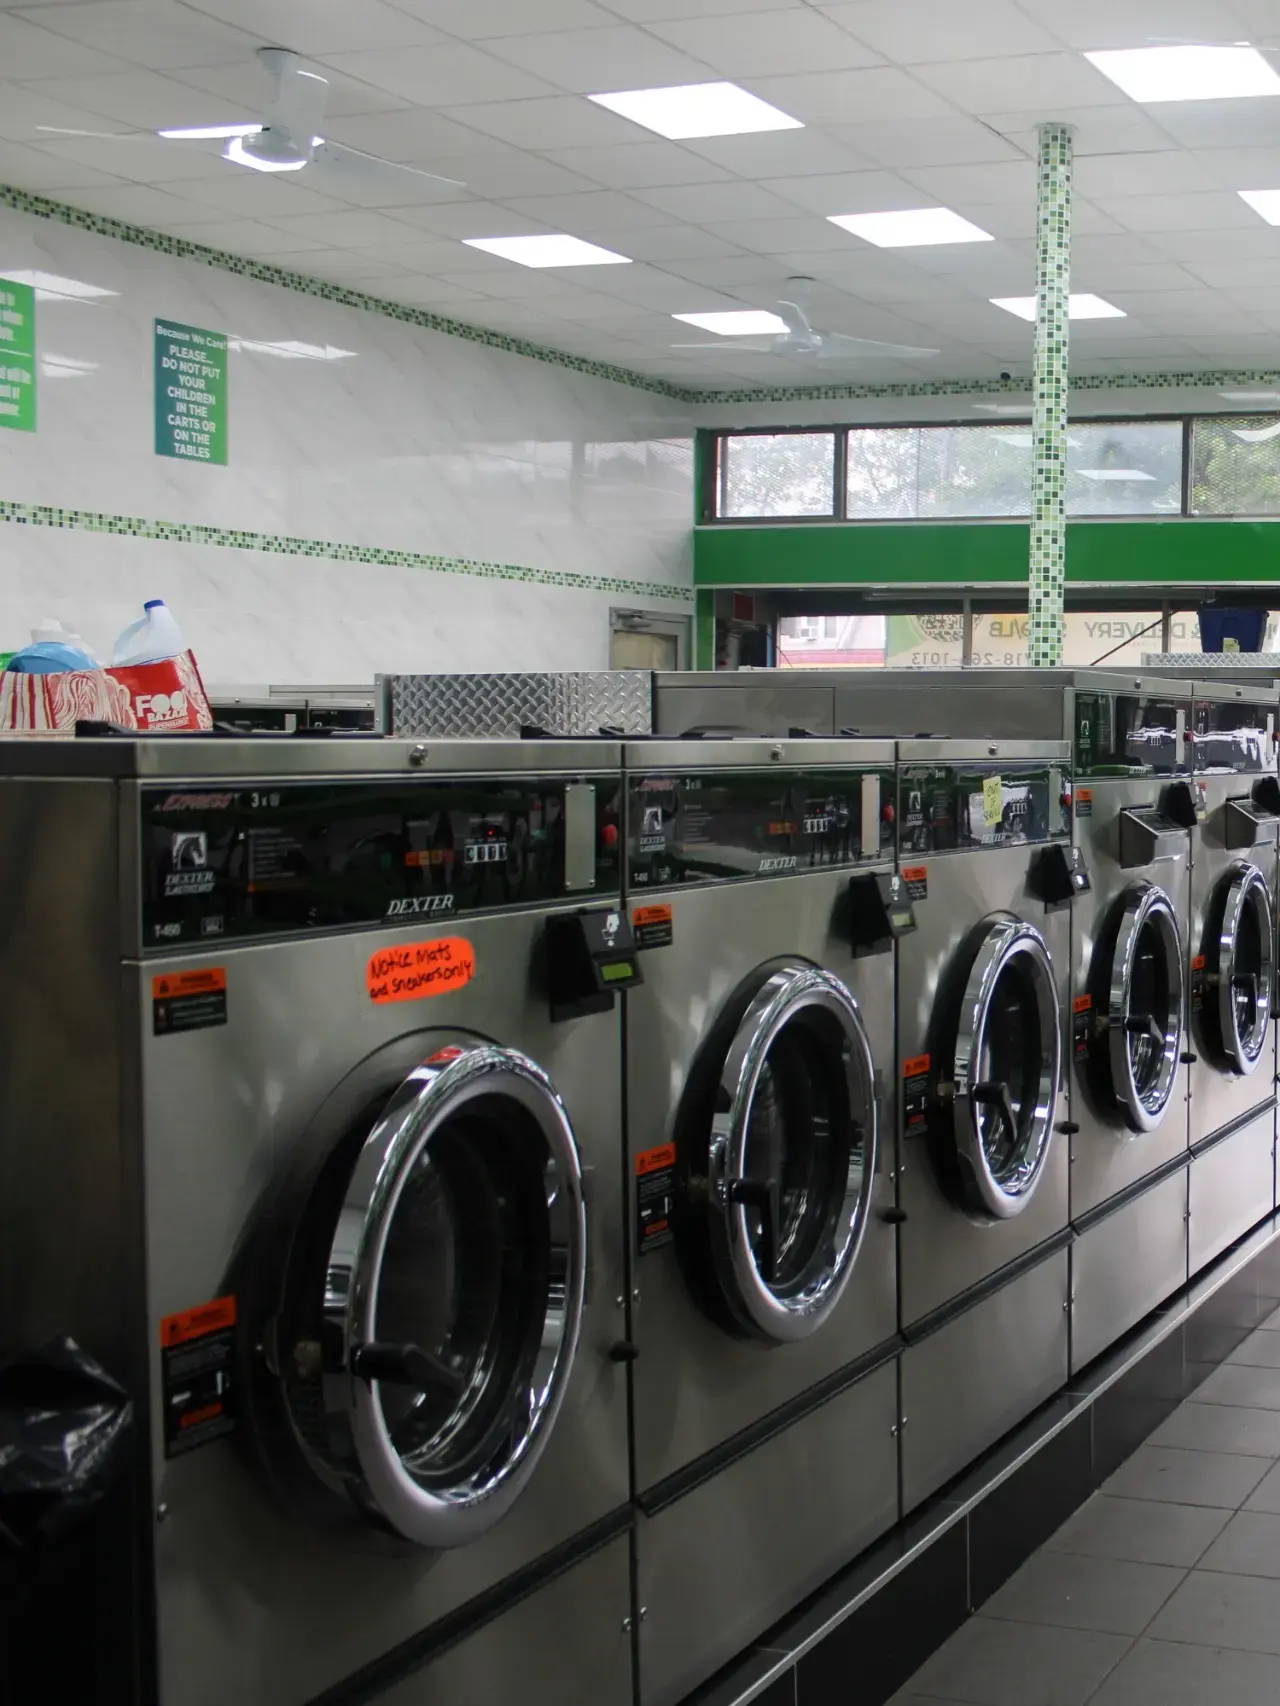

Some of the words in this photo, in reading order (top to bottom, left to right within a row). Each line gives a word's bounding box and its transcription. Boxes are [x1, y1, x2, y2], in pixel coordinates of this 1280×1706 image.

[156, 325, 190, 342] Because
[192, 332, 204, 345] We
[162, 357, 177, 370] DO
[179, 360, 200, 374] NOT
[202, 365, 221, 379] PUT
[178, 374, 206, 390] YOUR
[167, 385, 216, 405] CHILDREN
[176, 401, 187, 413] IN
[189, 404, 208, 418] THE
[167, 414, 200, 430] CARTS
[202, 420, 216, 433] OR
[174, 429, 189, 442] ON
[191, 432, 210, 445] THE
[174, 443, 210, 459] TABLES
[758, 856, 797, 871] DEXTER
[166, 871, 215, 885] DEXTER
[386, 894, 453, 915] DEXTER
[370, 982, 389, 998] and
